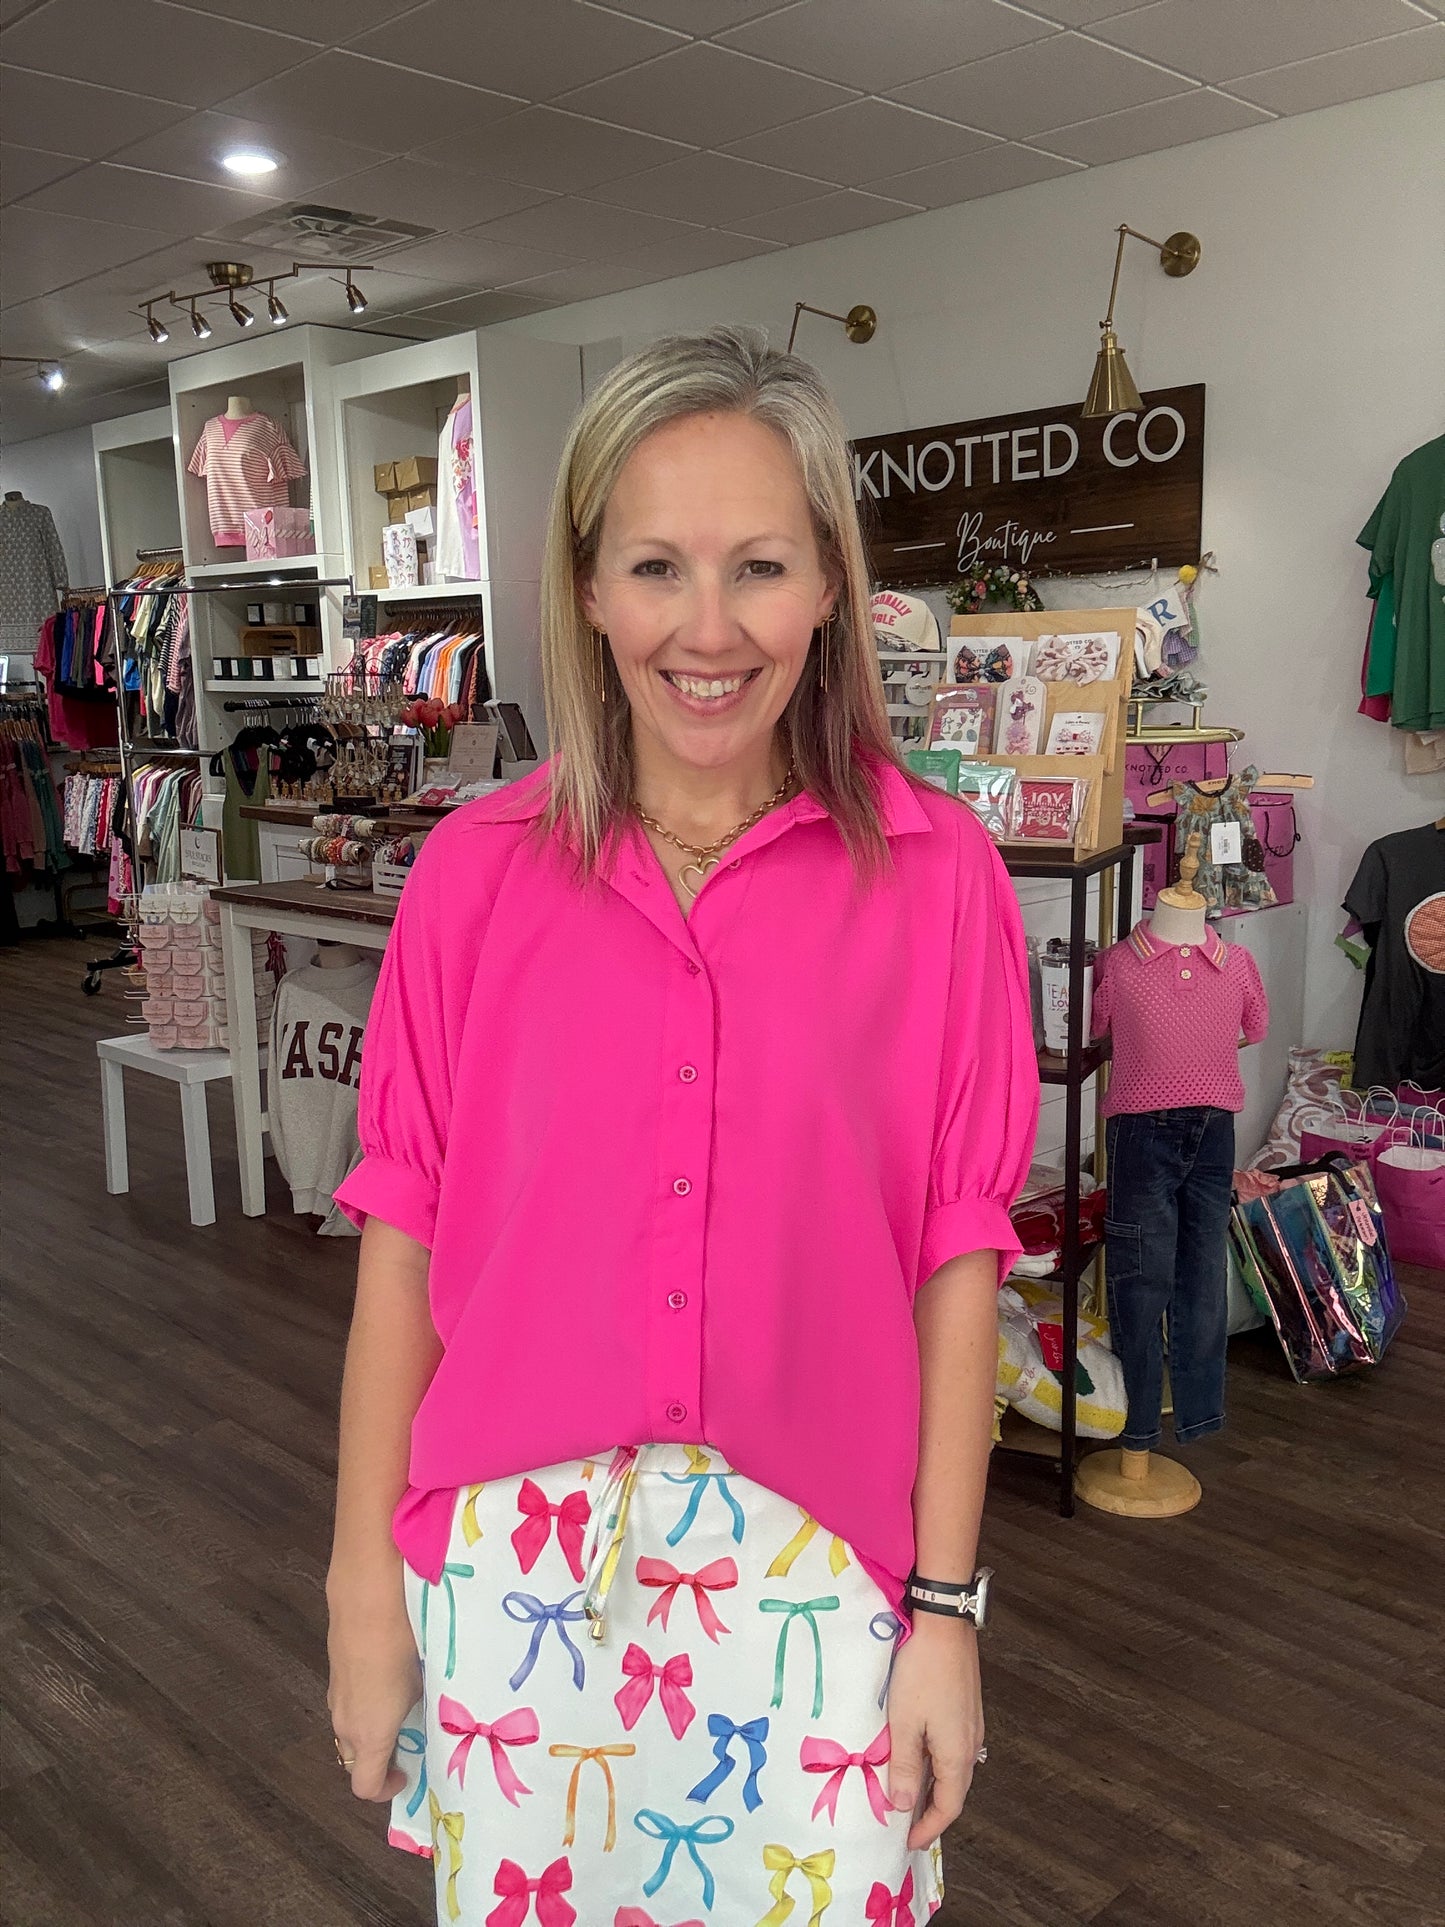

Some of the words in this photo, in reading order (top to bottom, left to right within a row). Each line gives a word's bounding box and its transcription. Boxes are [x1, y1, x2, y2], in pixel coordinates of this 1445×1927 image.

[854, 423, 1079, 500] KNOTTED
[1102, 406, 1186, 468] CO
[956, 511, 1057, 573] Boutique
[1147, 597, 1177, 626] R
[1031, 792, 1065, 806] JOY
[1046, 983, 1069, 998] TEA
[1052, 1000, 1069, 1008] LOV
[281, 1021, 362, 1090] ASH
